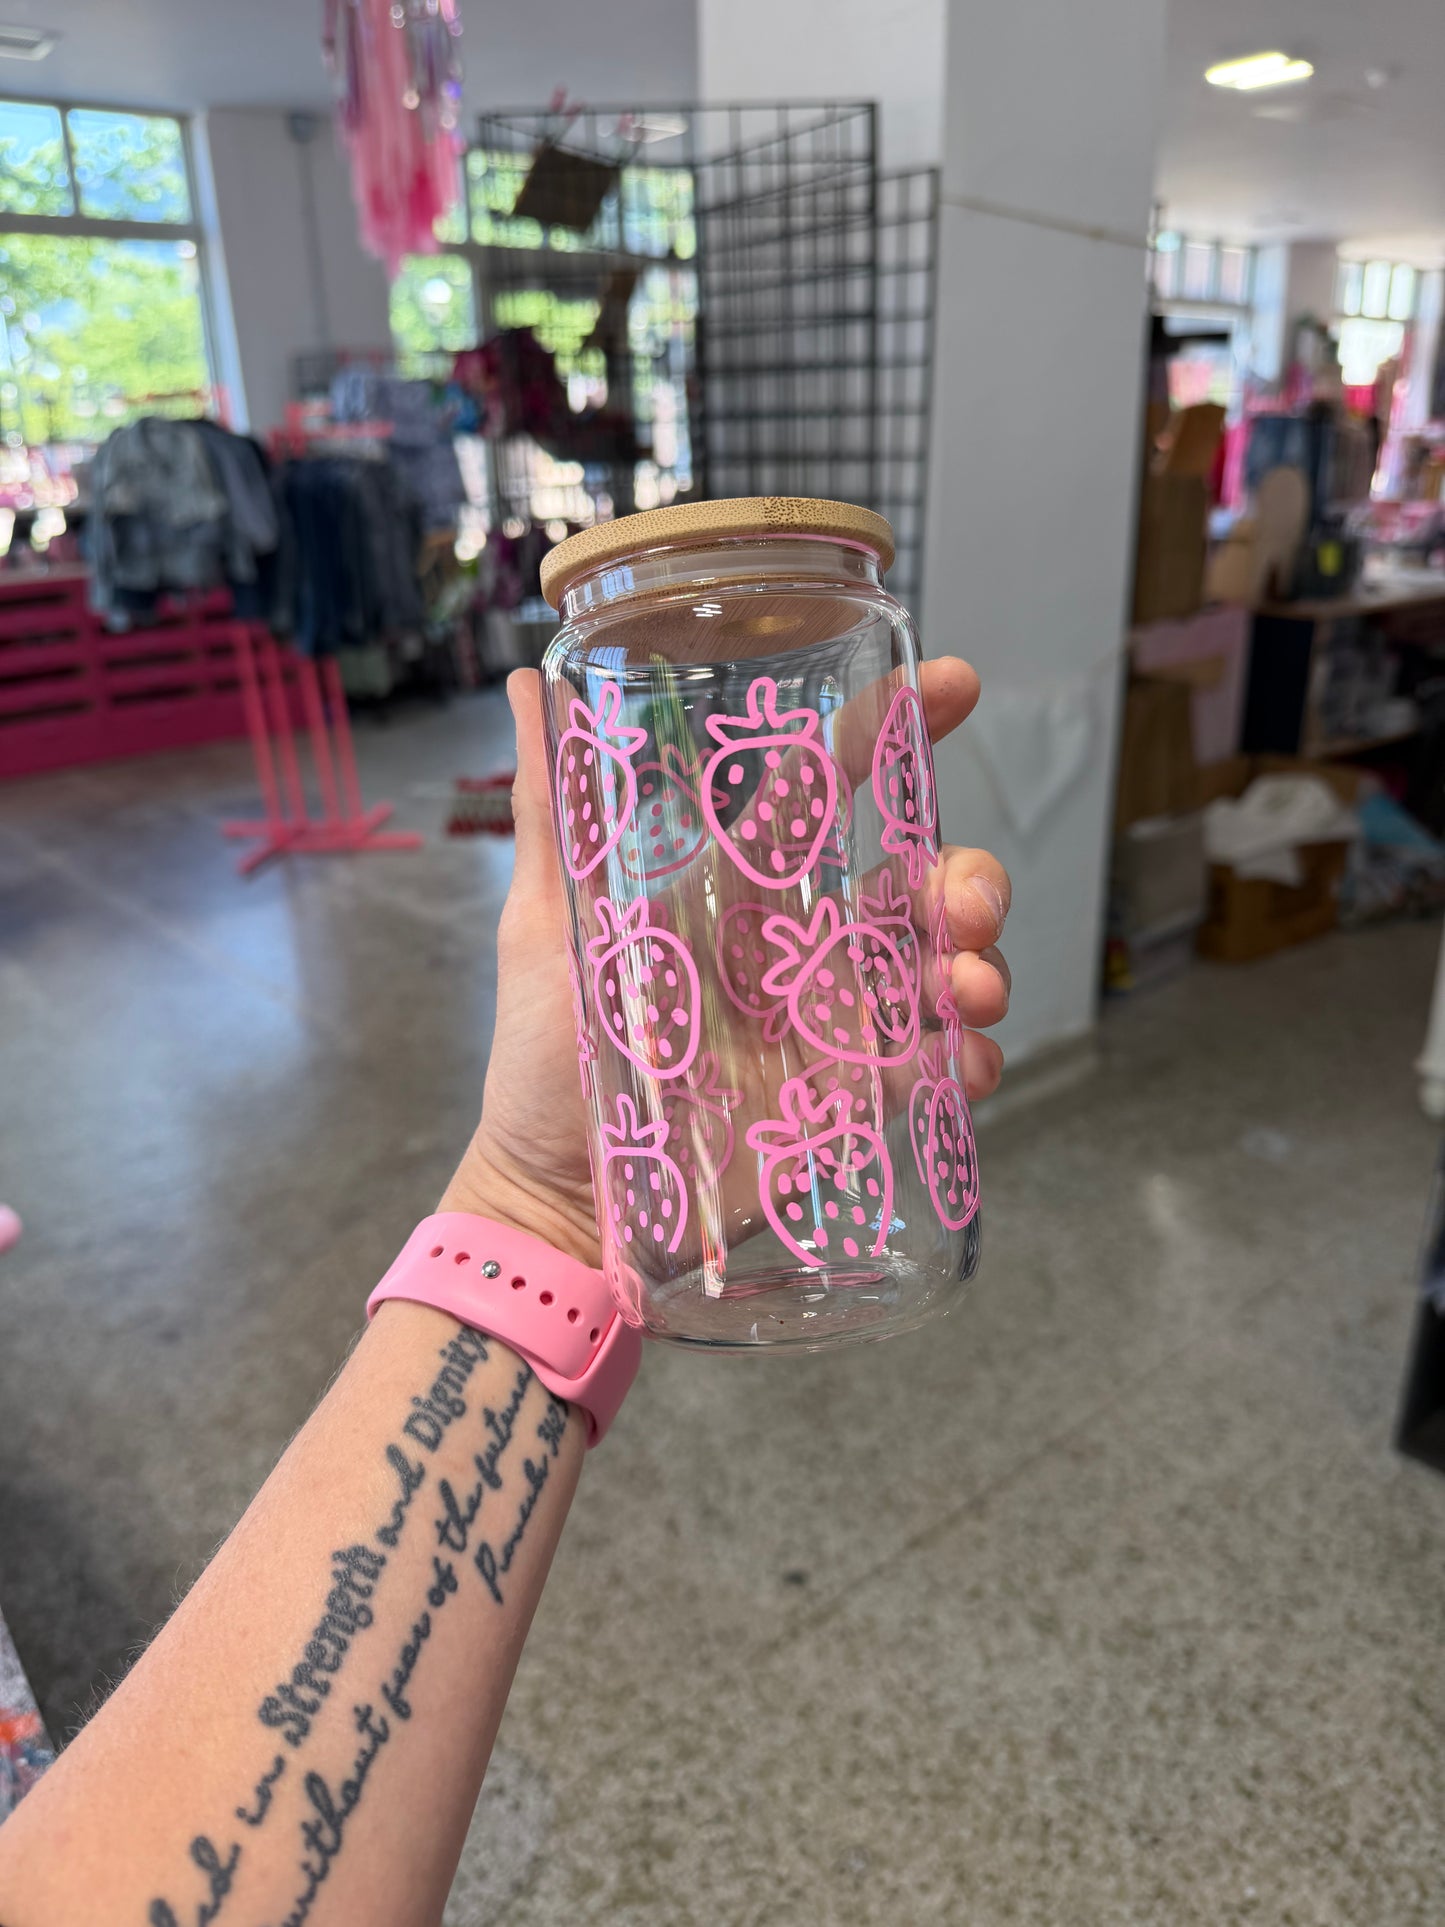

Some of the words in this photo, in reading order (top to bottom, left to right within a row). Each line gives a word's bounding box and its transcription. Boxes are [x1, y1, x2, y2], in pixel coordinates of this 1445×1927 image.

[376, 1442, 426, 1547] and
[434, 1479, 483, 1553] the
[427, 1556, 459, 1607] of
[258, 1544, 387, 1748] Strength
[235, 1755, 286, 1826] in
